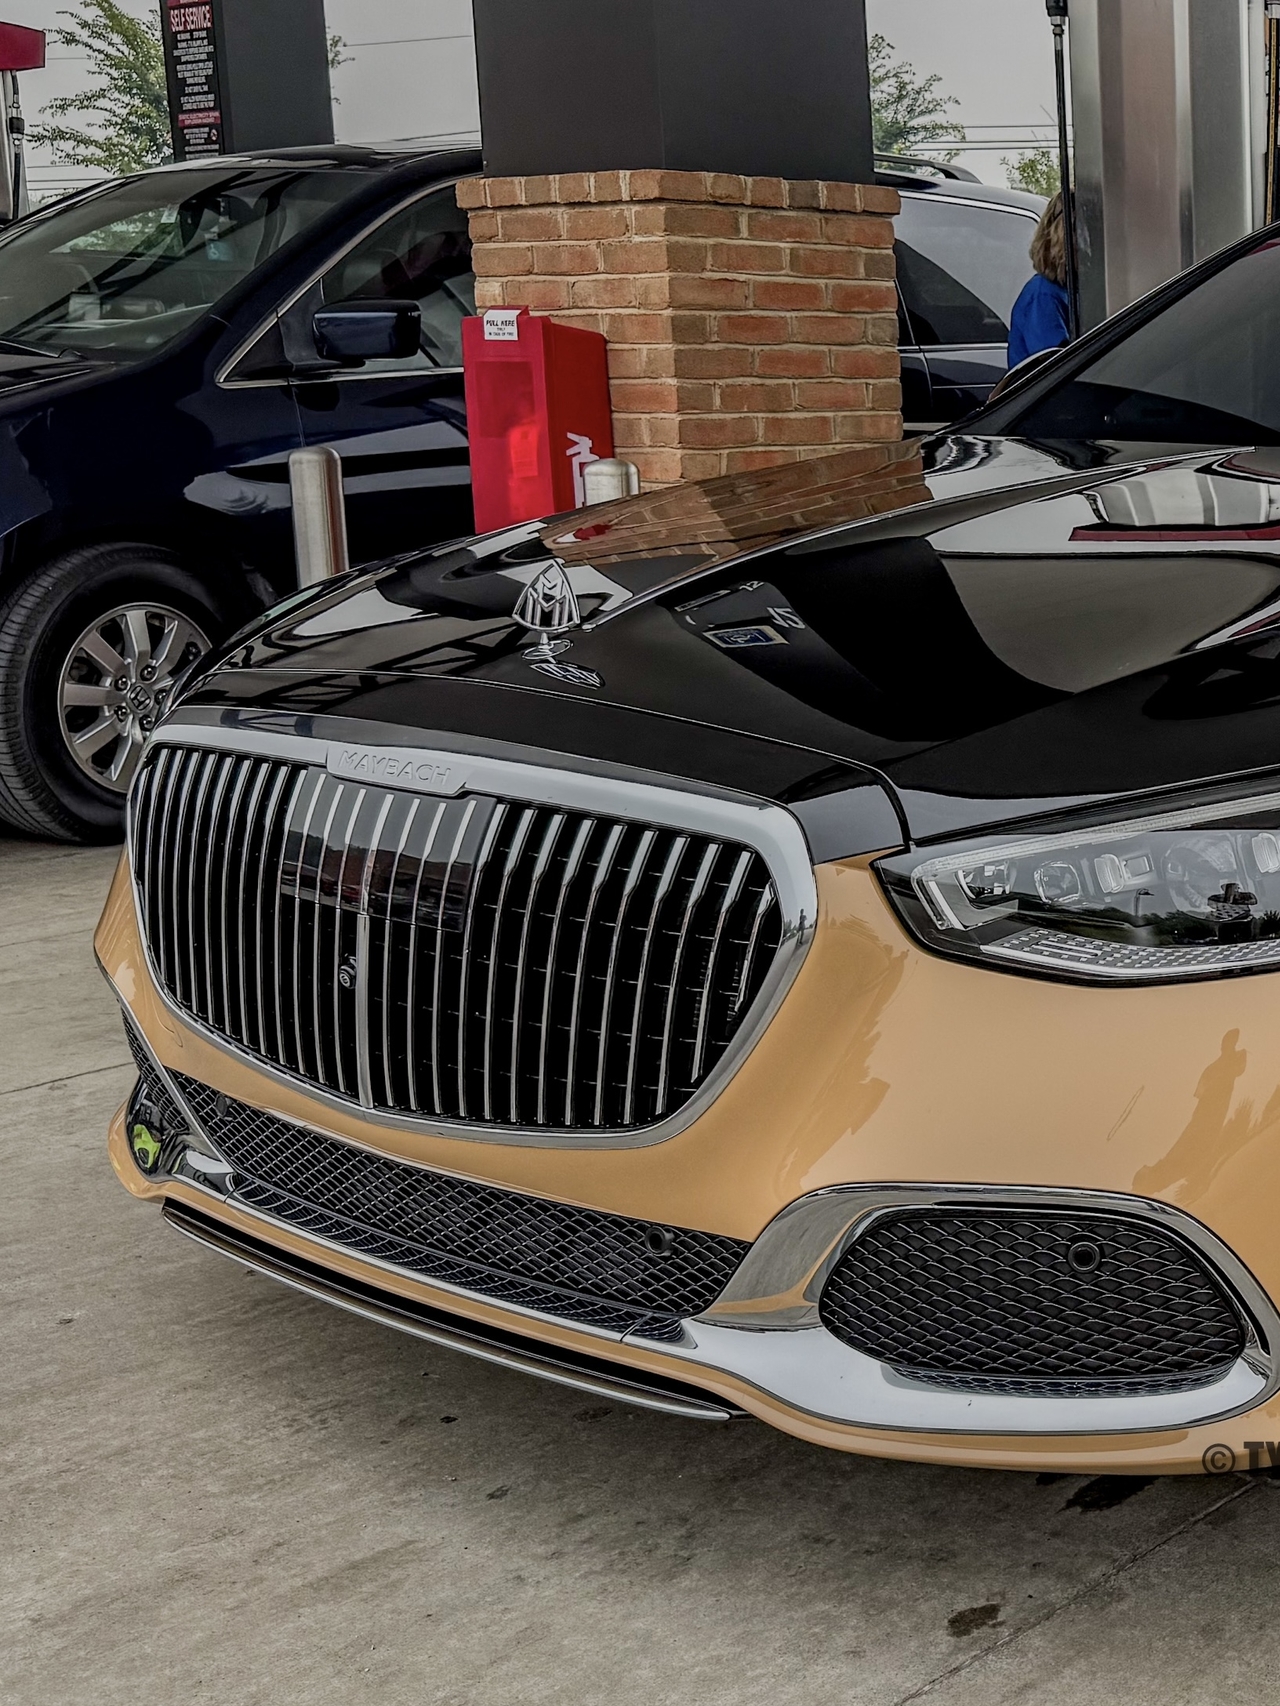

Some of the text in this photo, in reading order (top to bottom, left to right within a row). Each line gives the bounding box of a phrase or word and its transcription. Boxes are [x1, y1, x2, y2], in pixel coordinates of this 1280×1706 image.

[170, 5, 211, 32] SELF SERVICE
[338, 750, 451, 786] MAYBACH
